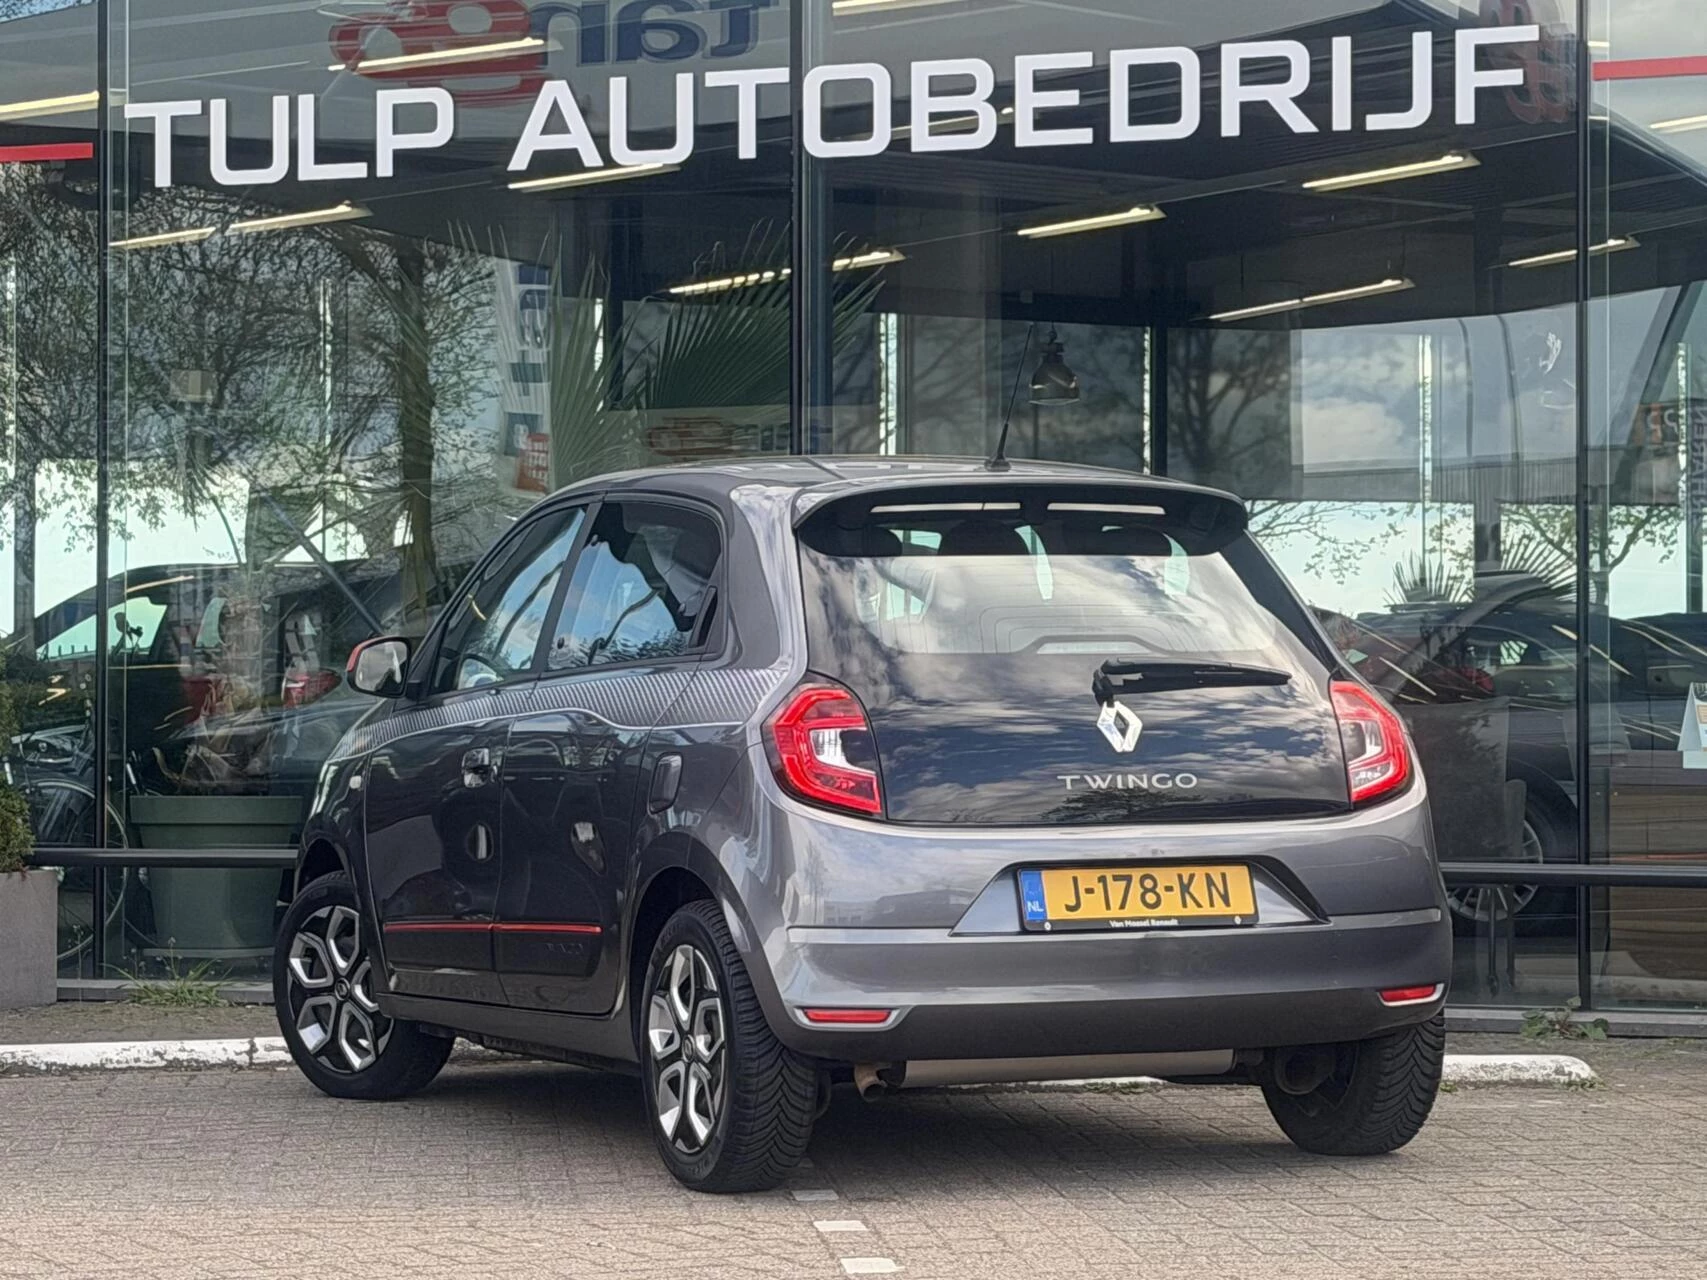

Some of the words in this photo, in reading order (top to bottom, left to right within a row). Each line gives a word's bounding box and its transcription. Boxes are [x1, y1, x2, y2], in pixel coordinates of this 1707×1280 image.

[124, 87, 455, 188] TULP
[506, 25, 1540, 172] AUTOBEDRIJF
[1056, 772, 1198, 790] TWINGO
[1026, 900, 1045, 912] NL
[1064, 871, 1232, 913] J-178-KN
